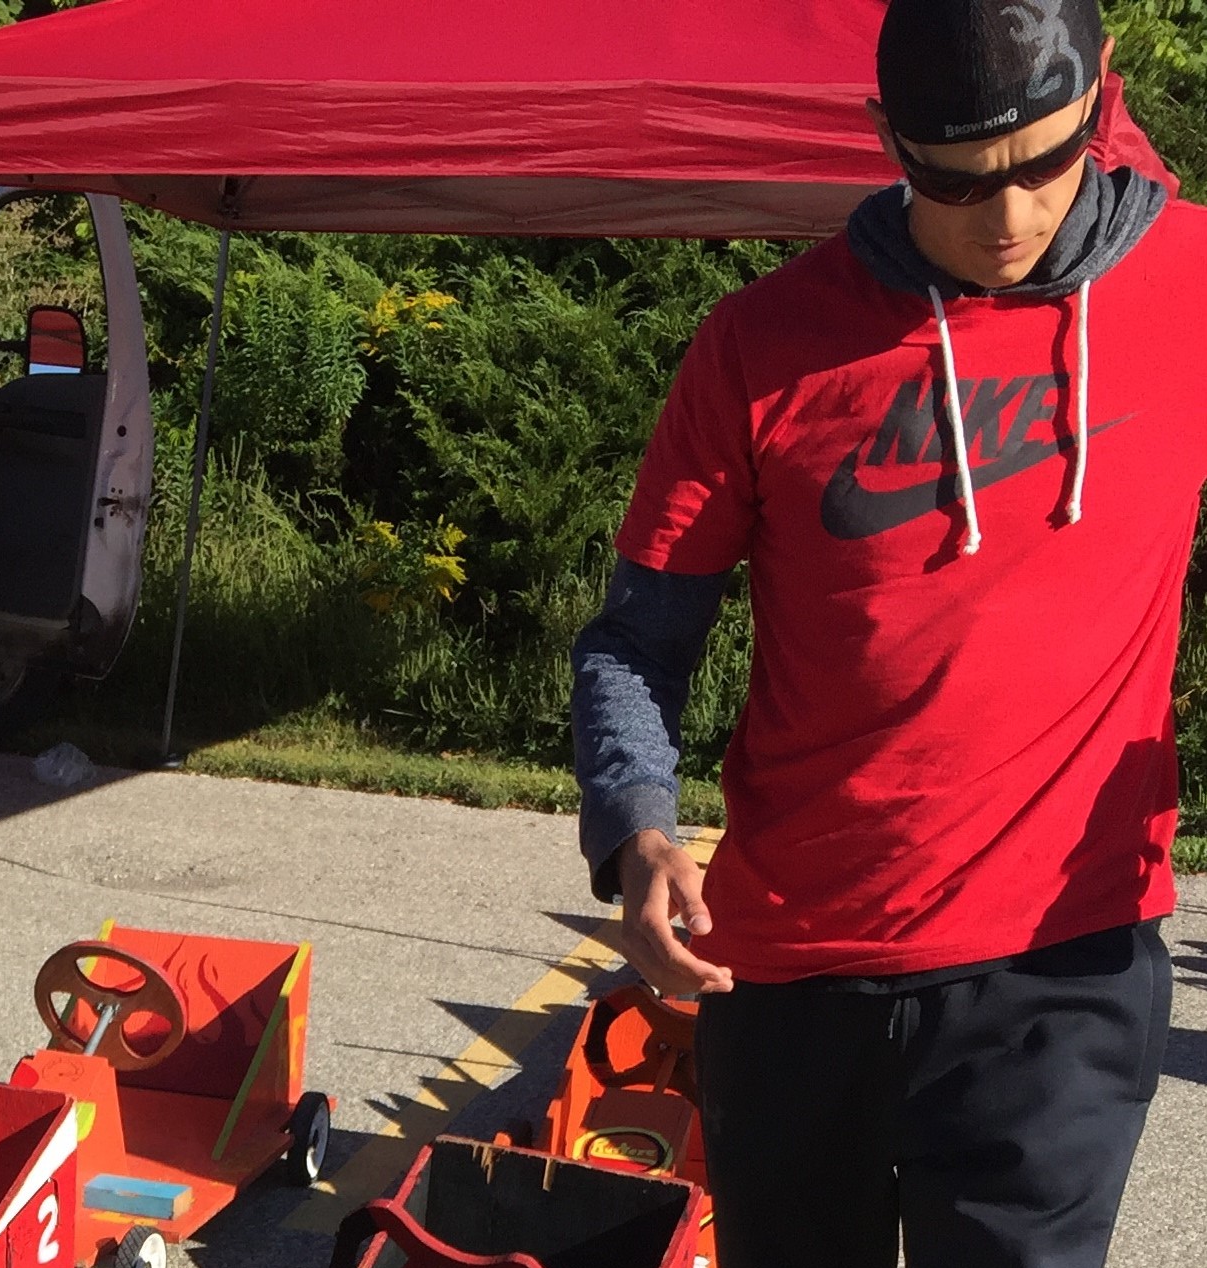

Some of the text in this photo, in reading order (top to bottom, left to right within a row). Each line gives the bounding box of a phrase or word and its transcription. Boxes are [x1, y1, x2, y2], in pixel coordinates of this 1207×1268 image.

[944, 107, 1018, 138] BROWNING
[864, 373, 1071, 466] NIKE
[38, 1193, 60, 1264] 2
